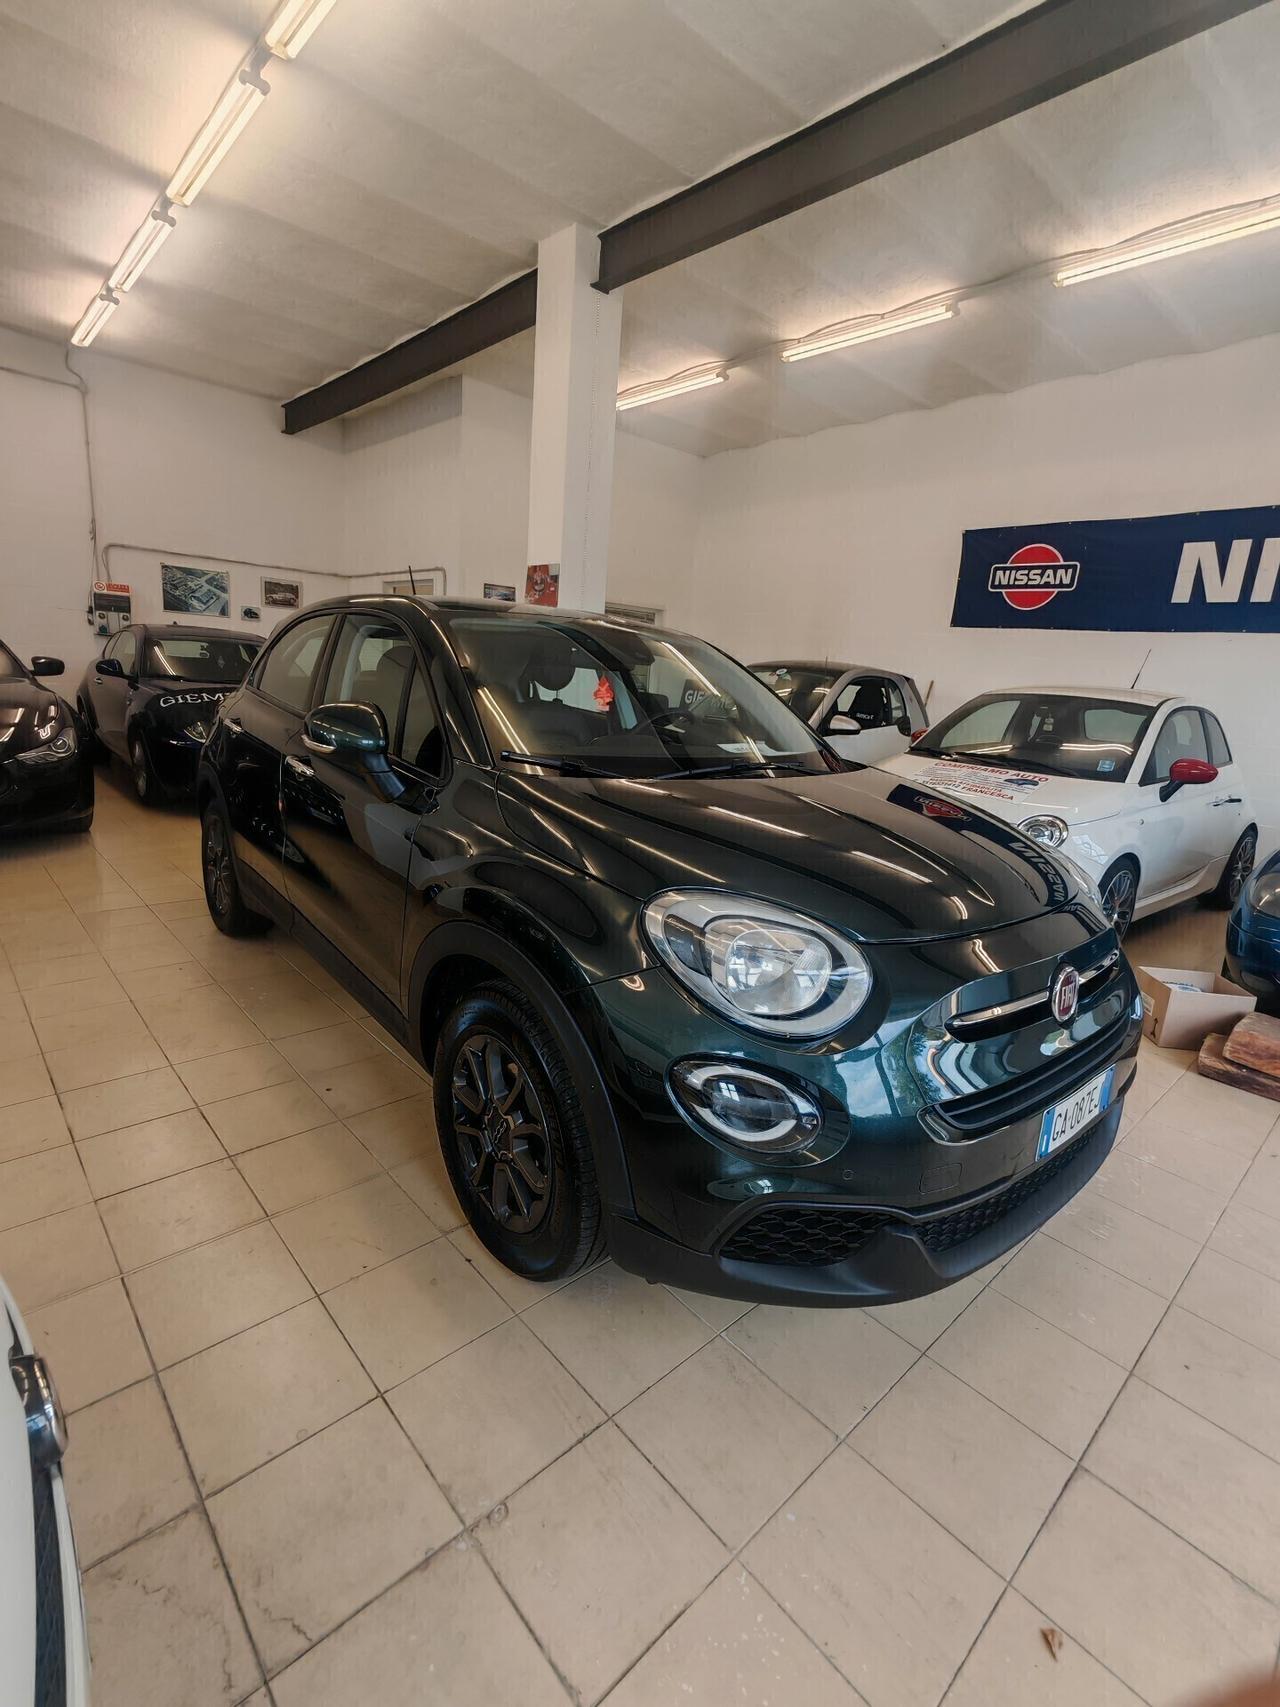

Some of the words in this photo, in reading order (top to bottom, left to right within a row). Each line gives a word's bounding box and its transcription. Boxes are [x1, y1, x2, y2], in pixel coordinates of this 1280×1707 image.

[994, 568, 1073, 586] NISSAN
[160, 692, 230, 708] GIEM
[934, 761, 1008, 775] COMPRIAMO
[1011, 772, 1049, 782] AUTO
[961, 786, 1014, 800] FRANCESCA
[1060, 982, 1076, 1011] FIAT
